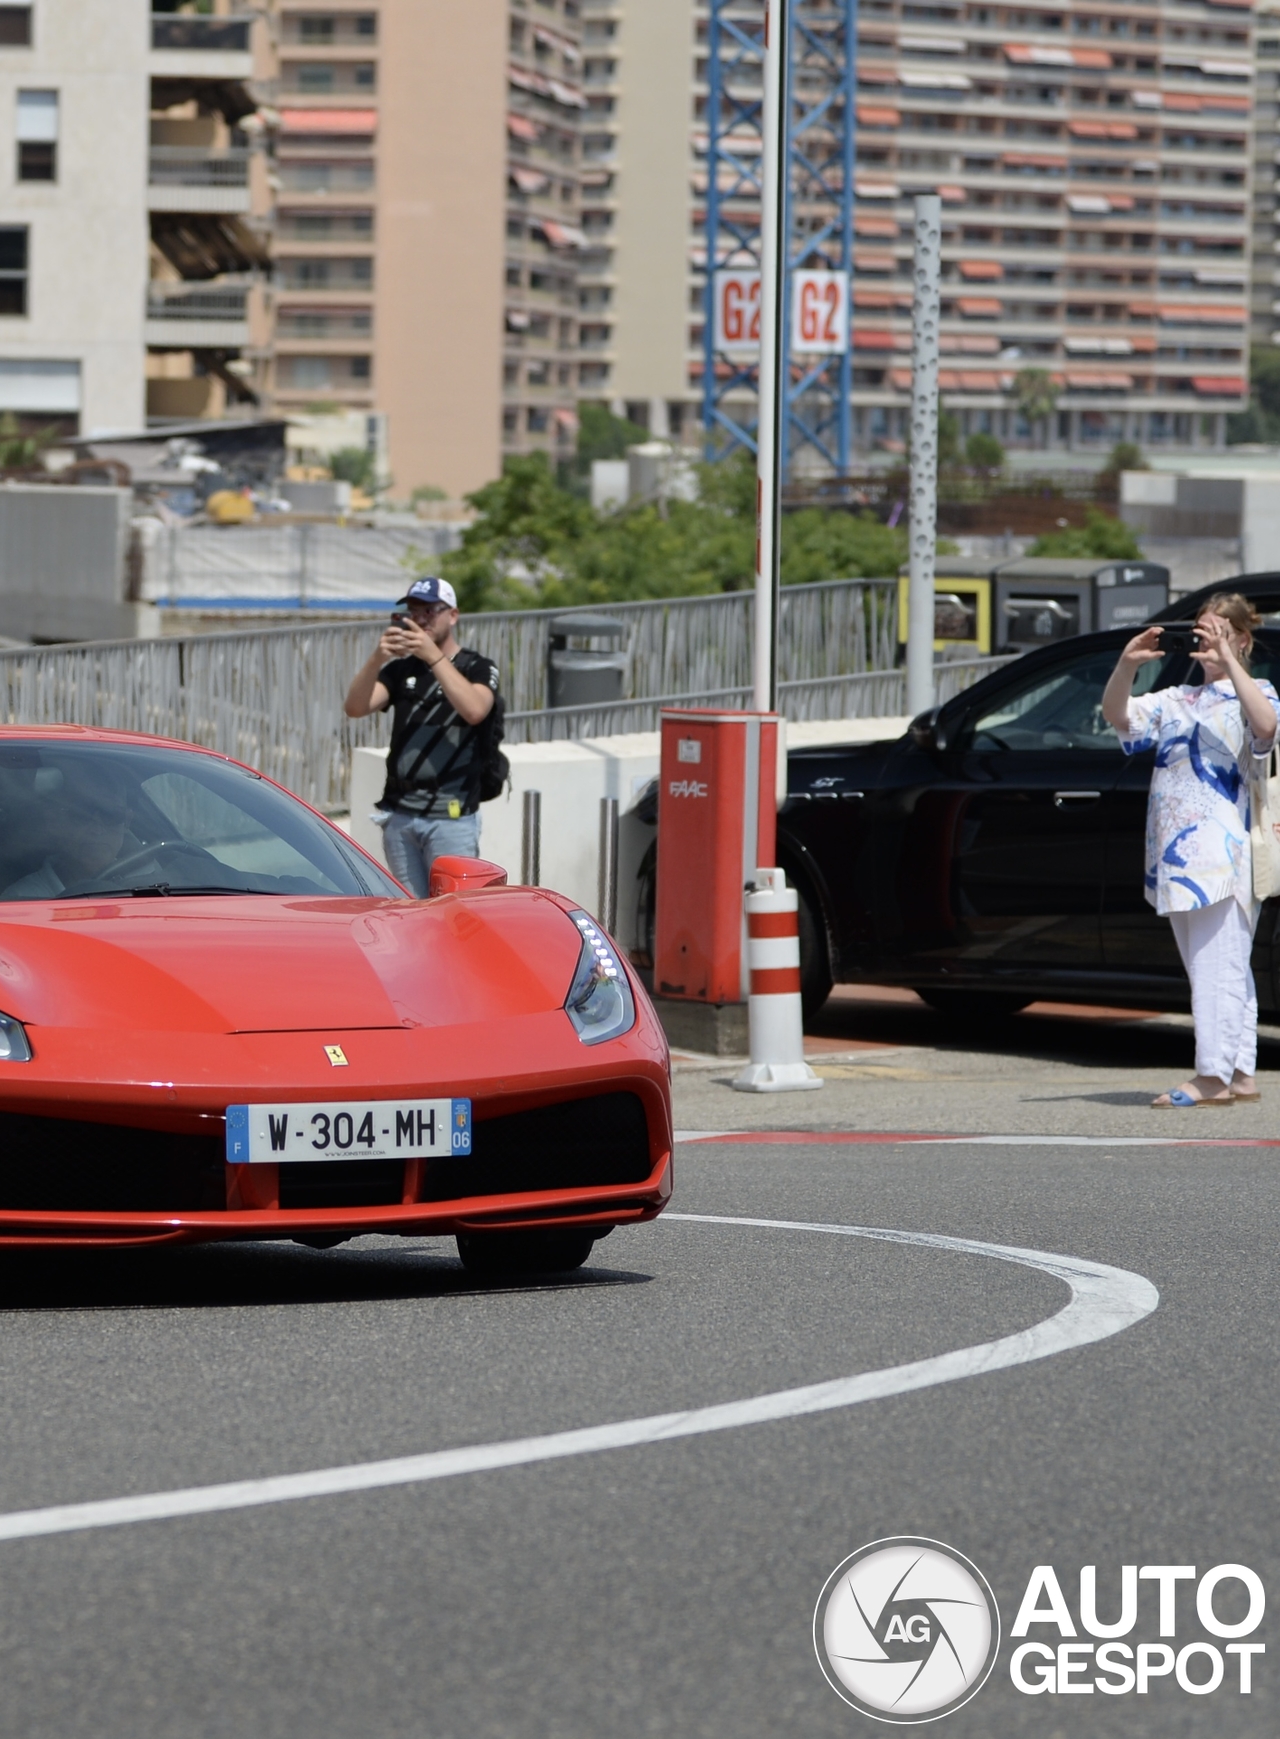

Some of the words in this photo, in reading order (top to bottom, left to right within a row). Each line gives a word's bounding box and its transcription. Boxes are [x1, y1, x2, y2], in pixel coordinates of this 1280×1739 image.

[801, 279, 840, 341] G2
[670, 780, 708, 798] FAAC
[452, 1131, 470, 1148] 06
[234, 1142, 242, 1155] F
